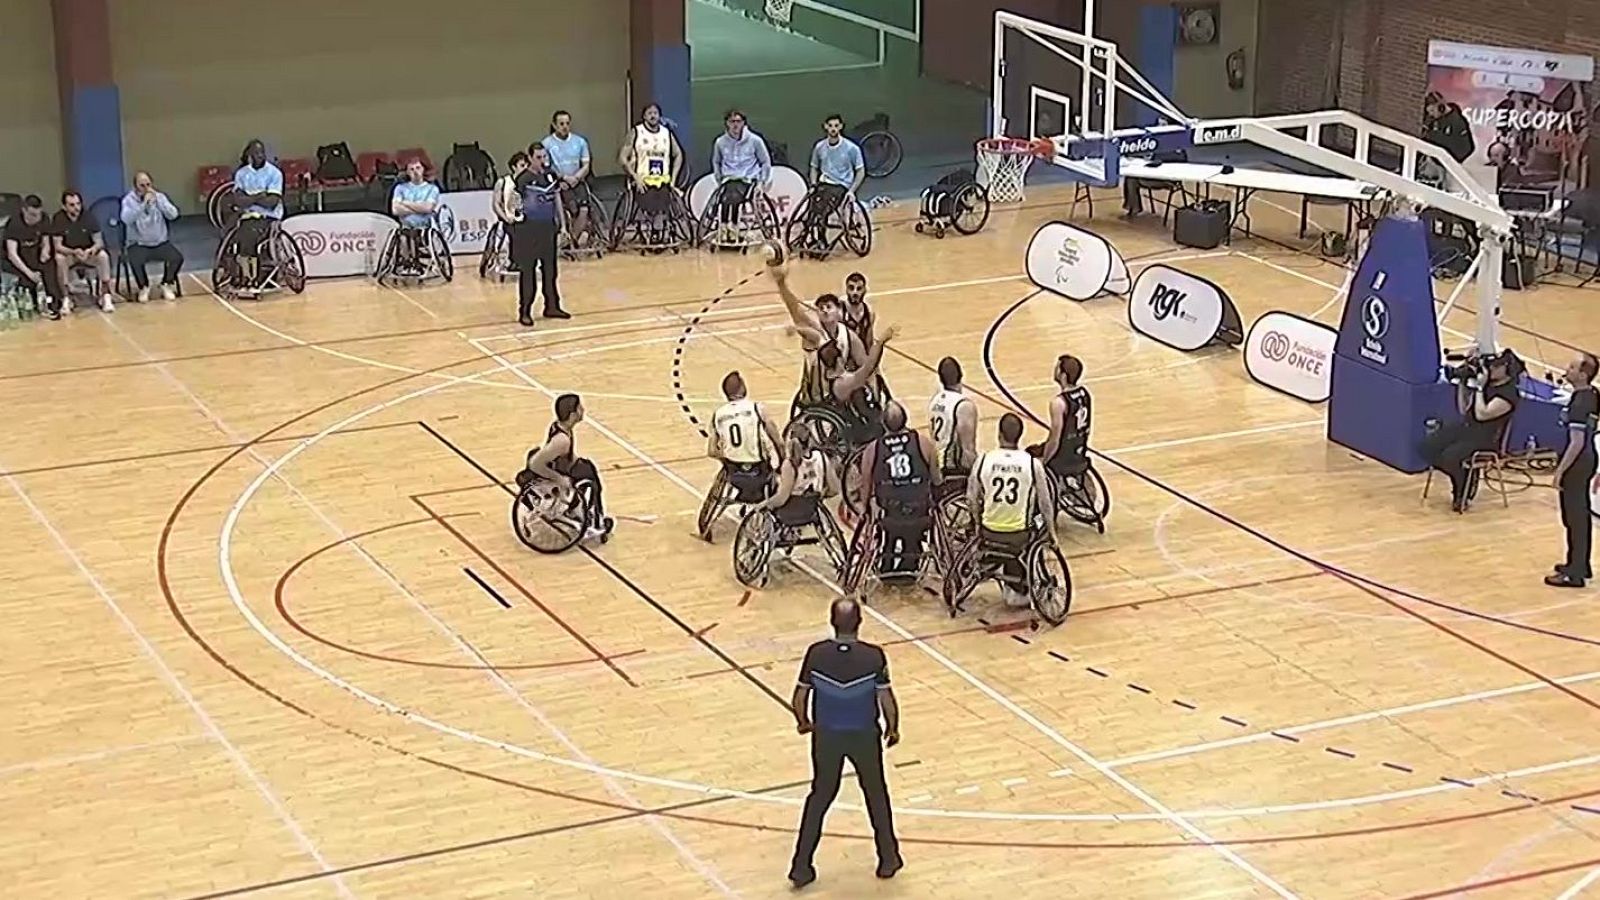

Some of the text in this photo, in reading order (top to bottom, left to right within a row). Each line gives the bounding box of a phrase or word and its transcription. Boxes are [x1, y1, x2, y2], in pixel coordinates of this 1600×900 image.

[1462, 107, 1573, 134] SUPERCOPA
[329, 240, 377, 253] ONCE
[1287, 353, 1324, 375] ONCE
[729, 423, 742, 448] 0
[930, 415, 944, 442] 12
[885, 453, 911, 478] 13
[992, 477, 1020, 505] 23
